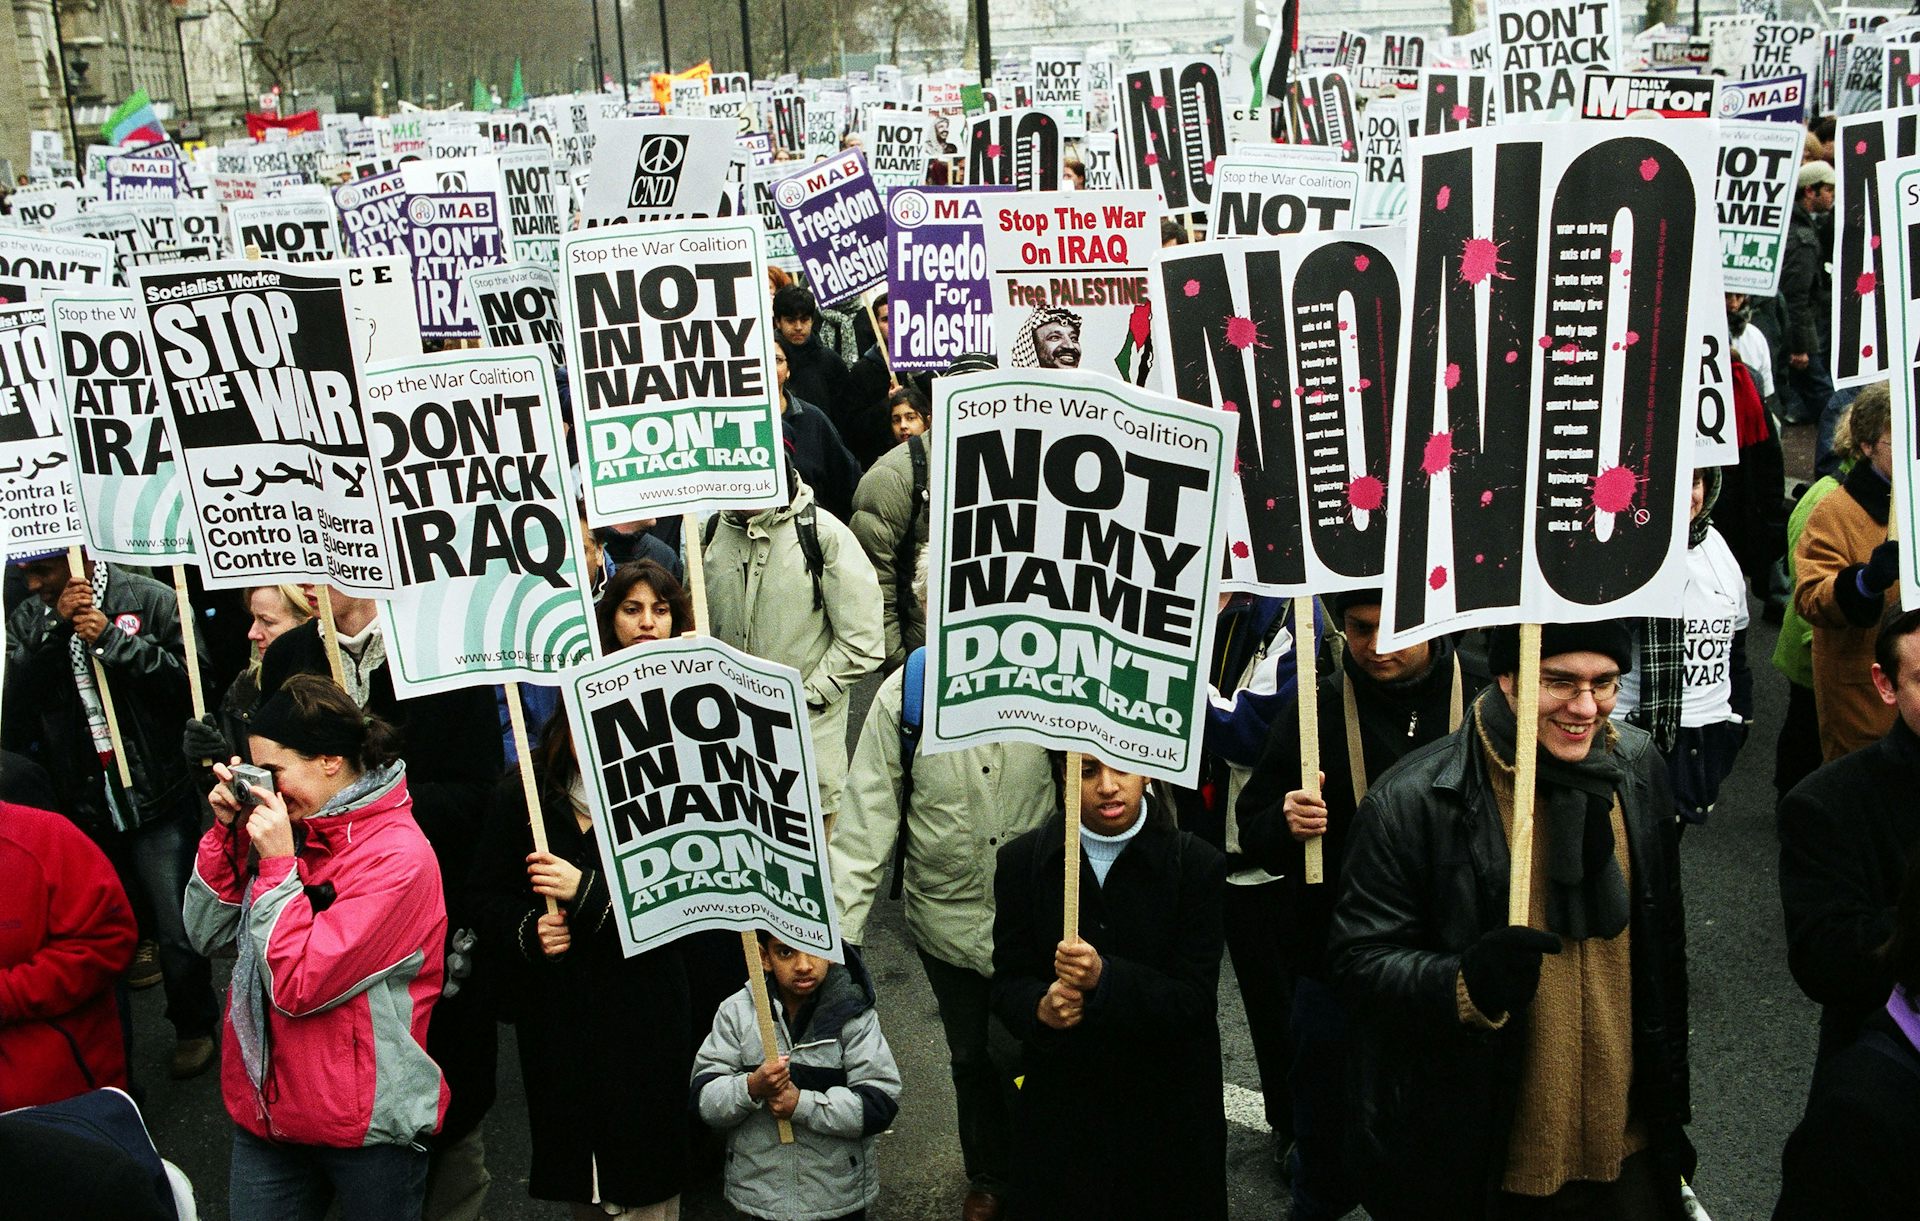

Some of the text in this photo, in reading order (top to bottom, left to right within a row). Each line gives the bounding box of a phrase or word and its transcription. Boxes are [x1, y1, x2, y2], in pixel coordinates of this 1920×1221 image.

[1499, 3, 1609, 44] DON'T
[1755, 26, 1815, 45] STOP
[1384, 35, 1424, 66] NO
[1504, 36, 1610, 70] ATTACK
[1753, 44, 1792, 64] THE
[1036, 61, 1082, 77] NOT
[1055, 79, 1081, 89] MY
[1631, 79, 1669, 89] DAILY
[1036, 90, 1081, 101] NAME
[1586, 76, 1711, 118] Mirror
[1748, 86, 1798, 108] MAB
[808, 131, 836, 144] IRAQ
[878, 125, 922, 144] NOT
[1127, 62, 1227, 208] NO
[437, 146, 477, 158] DON'T
[875, 158, 920, 170] NAME
[876, 144, 893, 157] IN
[969, 110, 1058, 190] NO
[131, 162, 170, 175] MAB
[505, 166, 550, 196] NOT
[806, 160, 859, 193] MAB
[1224, 171, 1351, 188] Stop the War Coalition
[111, 178, 176, 200] Freedom
[362, 177, 405, 199] MAB
[631, 176, 674, 206] CND
[1727, 180, 1786, 203] MY
[293, 207, 326, 216] Coalition
[438, 203, 490, 218] MAB
[510, 196, 531, 216] IN
[789, 188, 880, 248] Freedom
[934, 200, 982, 219] MA
[999, 206, 1146, 236] Stop The War
[1218, 191, 1351, 236] NOT
[242, 221, 329, 252] NOT
[512, 216, 560, 235] NAME
[1557, 224, 1575, 235] war
[1589, 223, 1608, 235] iraq
[10, 240, 101, 258] the War Coalition
[412, 227, 498, 256] DON'T
[572, 237, 747, 263] Stop the War Coalition
[830, 230, 857, 252] For
[897, 231, 989, 281] Freedo
[1022, 234, 1128, 265] On IRAQ
[1560, 249, 1579, 260] axis
[1580, 248, 1590, 260] of
[417, 256, 498, 280] ATTACK
[1734, 256, 1774, 271] IRAQ
[146, 272, 281, 302] Socialist Worker
[474, 272, 528, 289] Stop War
[574, 261, 753, 329] NOT
[935, 283, 970, 305] For
[1007, 276, 1148, 306] Free PALESTINE
[1555, 274, 1603, 286] brute force
[59, 306, 88, 324] Stop
[91, 306, 116, 320] the
[416, 280, 475, 326] IRA
[479, 286, 558, 325] NOT
[1553, 299, 1603, 313] friendly fire
[153, 290, 299, 380] STOP
[488, 325, 523, 347] IN
[580, 326, 644, 370] IN
[660, 318, 756, 361] MY
[894, 300, 997, 358] Palestin
[1555, 325, 1598, 338] body bags
[1576, 350, 1598, 363] price
[397, 367, 535, 395] the War Coalition
[584, 358, 764, 411] NAME
[1394, 136, 1696, 634] NO
[1554, 374, 1594, 386] collateral
[172, 367, 364, 446] THE WAR
[1161, 241, 1402, 584] NO
[1546, 399, 1599, 411] smart bombs
[372, 393, 541, 468] DON'T
[590, 410, 767, 462] DON'T
[957, 393, 1208, 453] Stop the War Coalition
[1553, 424, 1589, 437] orphans
[74, 417, 174, 476] IRA
[1546, 448, 1594, 461] imperialism
[332, 459, 368, 498] لا
[596, 447, 770, 481] ATTACK IRAQ
[1548, 472, 1589, 485] hypocrisy
[384, 454, 556, 510] ATTACK
[640, 479, 771, 501] www.stopwar.org.uk
[954, 428, 1210, 536] NOT
[1550, 496, 1583, 508] heroics
[66, 517, 82, 532] la
[202, 501, 375, 536] Contra la guerra
[1548, 520, 1571, 532] quick
[208, 524, 379, 560] Contro la guerra
[392, 503, 572, 588] IRAQ
[951, 504, 1201, 592] IN MY
[213, 547, 384, 582] Contre la guerre
[948, 556, 1195, 647] NAME
[1686, 619, 1731, 634] EACE
[946, 620, 1188, 707] DON'T
[586, 658, 785, 700] Stop the War Coalition
[945, 667, 1183, 734] ATTACK IRAQ
[590, 683, 793, 766] NOT
[997, 707, 1178, 762] www.stopwar.org.uk
[603, 741, 800, 807] IN MY
[611, 783, 811, 851] NAME
[622, 834, 815, 898] DON'T
[632, 870, 821, 920] ATTACK IRAQ
[683, 901, 825, 942] www.stopwar.org.uk
